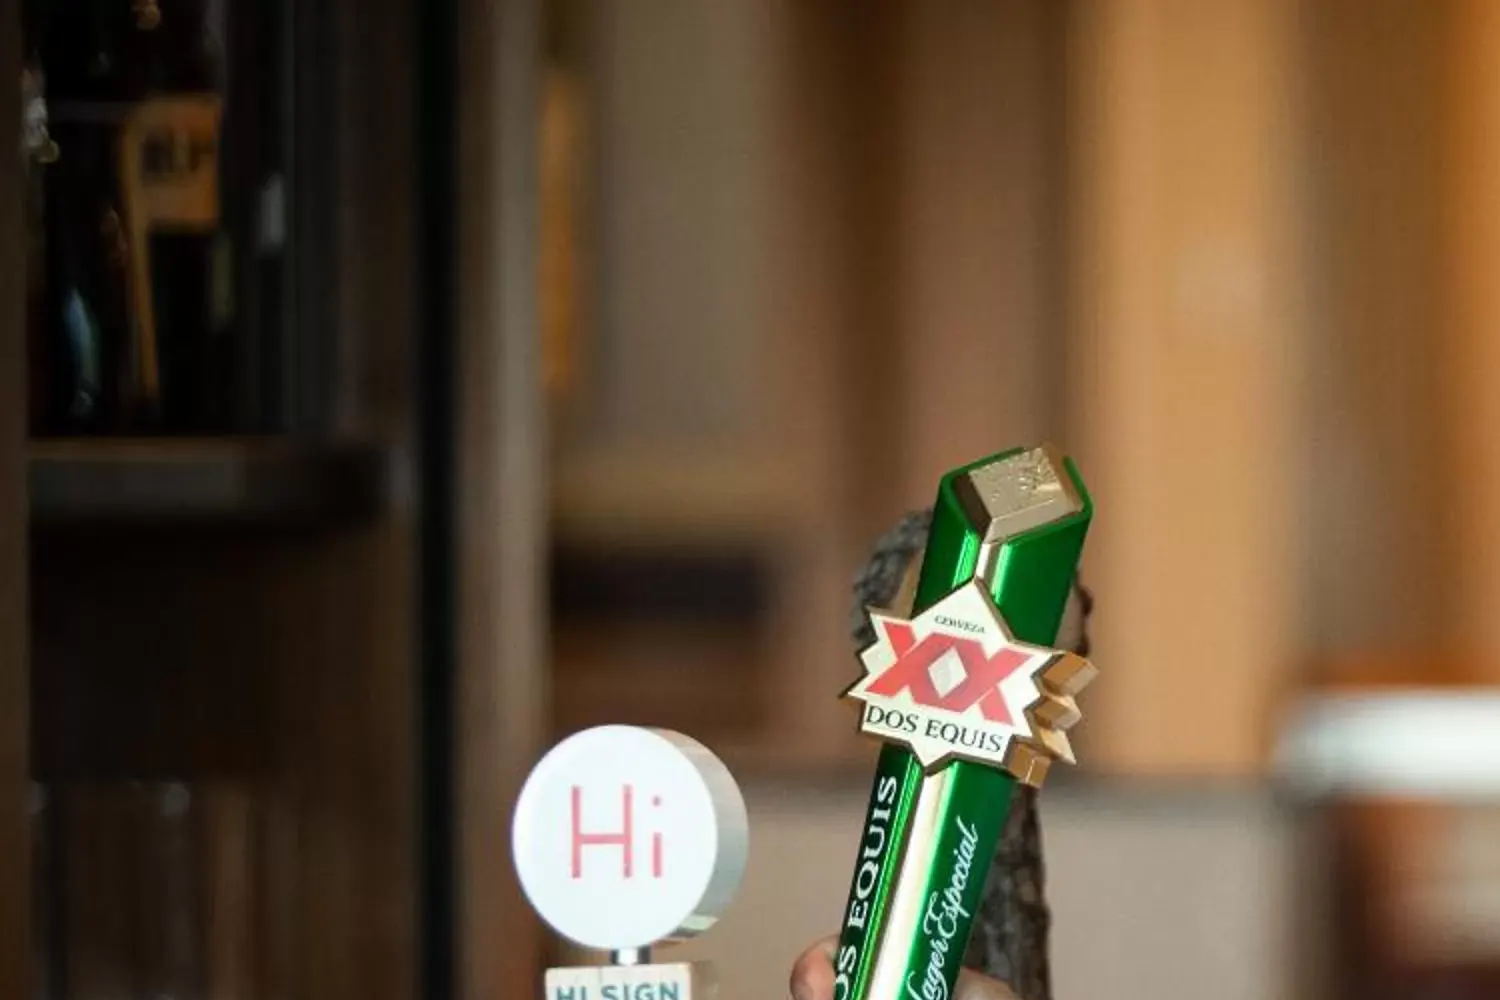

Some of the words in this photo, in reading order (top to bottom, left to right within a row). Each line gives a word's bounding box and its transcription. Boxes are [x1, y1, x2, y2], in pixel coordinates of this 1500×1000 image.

[934, 614, 986, 634] CERVEZA
[865, 704, 919, 733] DOS
[924, 718, 1004, 752] EQUIS
[571, 784, 662, 879] Hi
[847, 775, 897, 929] EQUIS
[923, 815, 978, 938] Especial
